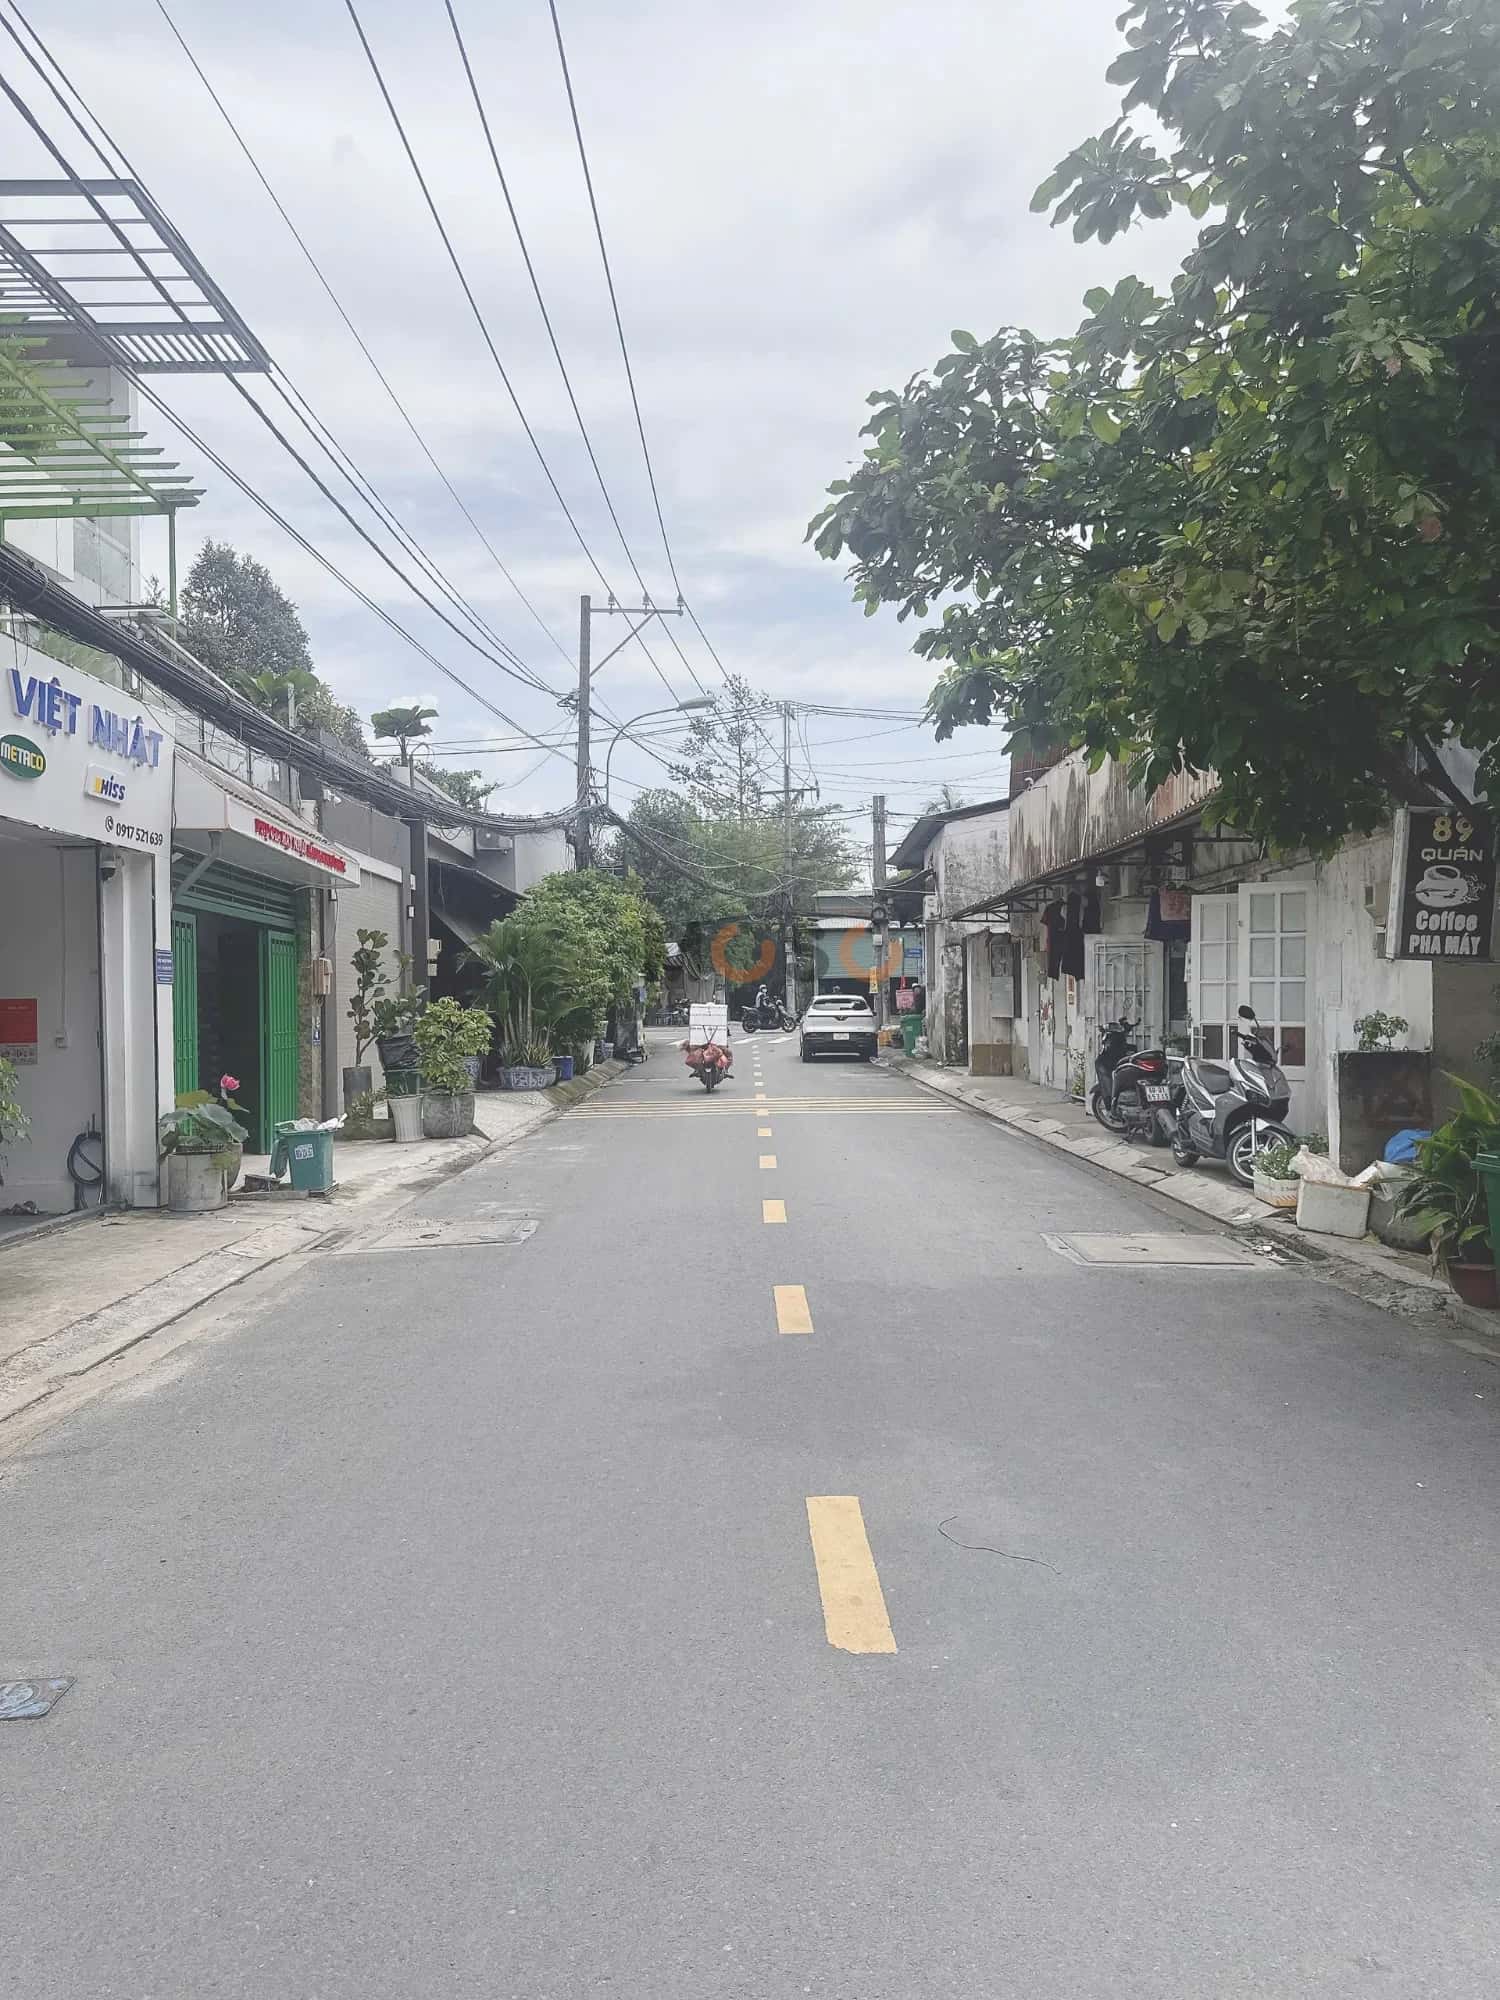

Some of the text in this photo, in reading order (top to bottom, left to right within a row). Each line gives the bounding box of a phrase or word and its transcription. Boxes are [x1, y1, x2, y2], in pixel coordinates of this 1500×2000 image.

[8, 668, 164, 768] VIỆT NHẬT
[0, 741, 44, 771] METACO
[116, 823, 164, 846] 0917 521 639
[1432, 816, 1473, 842] 89
[1409, 932, 1481, 955] PHA MÁY
